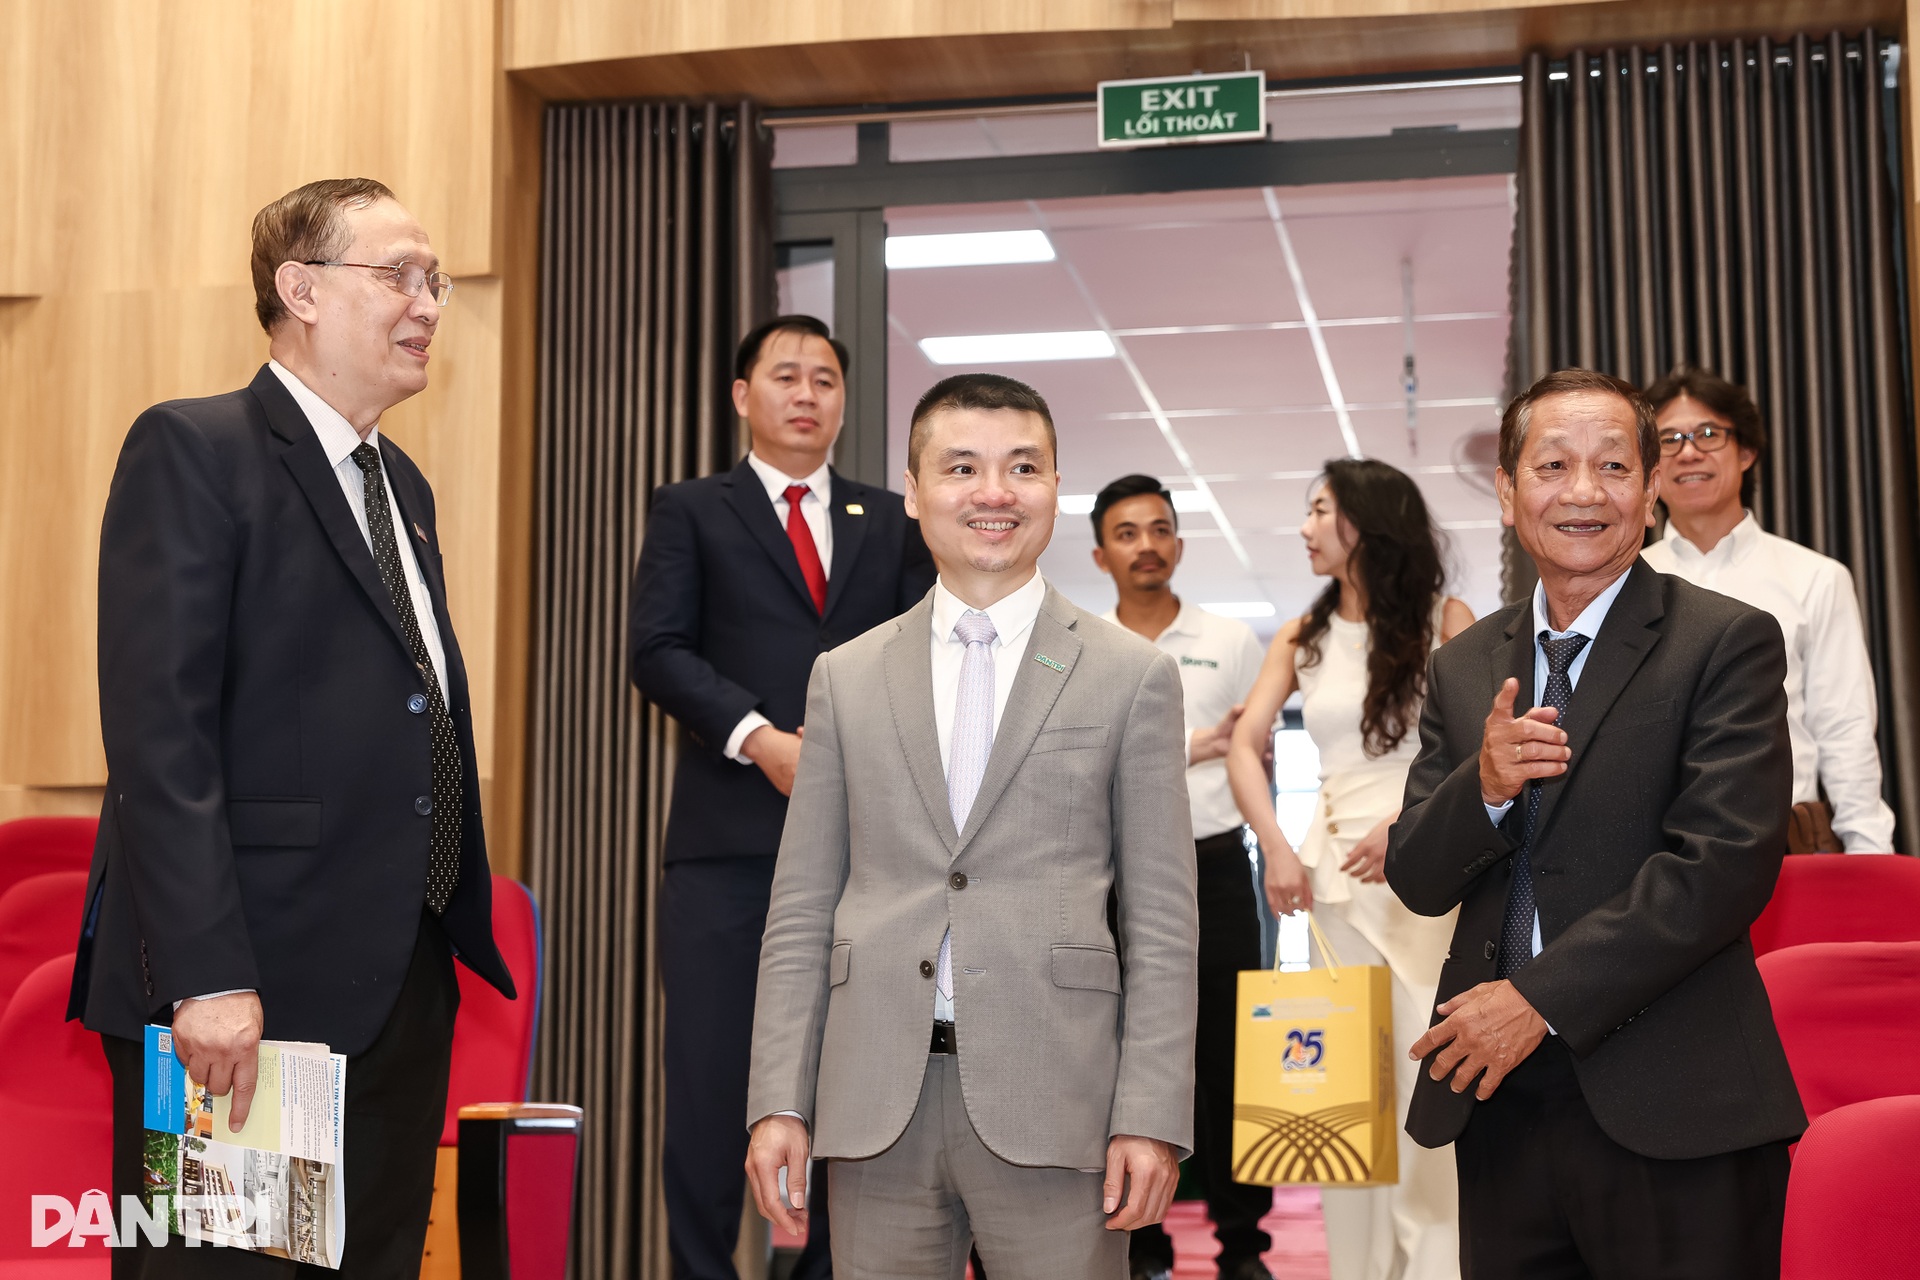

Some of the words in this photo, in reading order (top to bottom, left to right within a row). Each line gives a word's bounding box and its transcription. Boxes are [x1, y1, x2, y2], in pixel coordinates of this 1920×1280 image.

[1140, 86, 1220, 111] EXIT
[1124, 112, 1160, 135] LỐI
[1163, 109, 1239, 133] THOÁT
